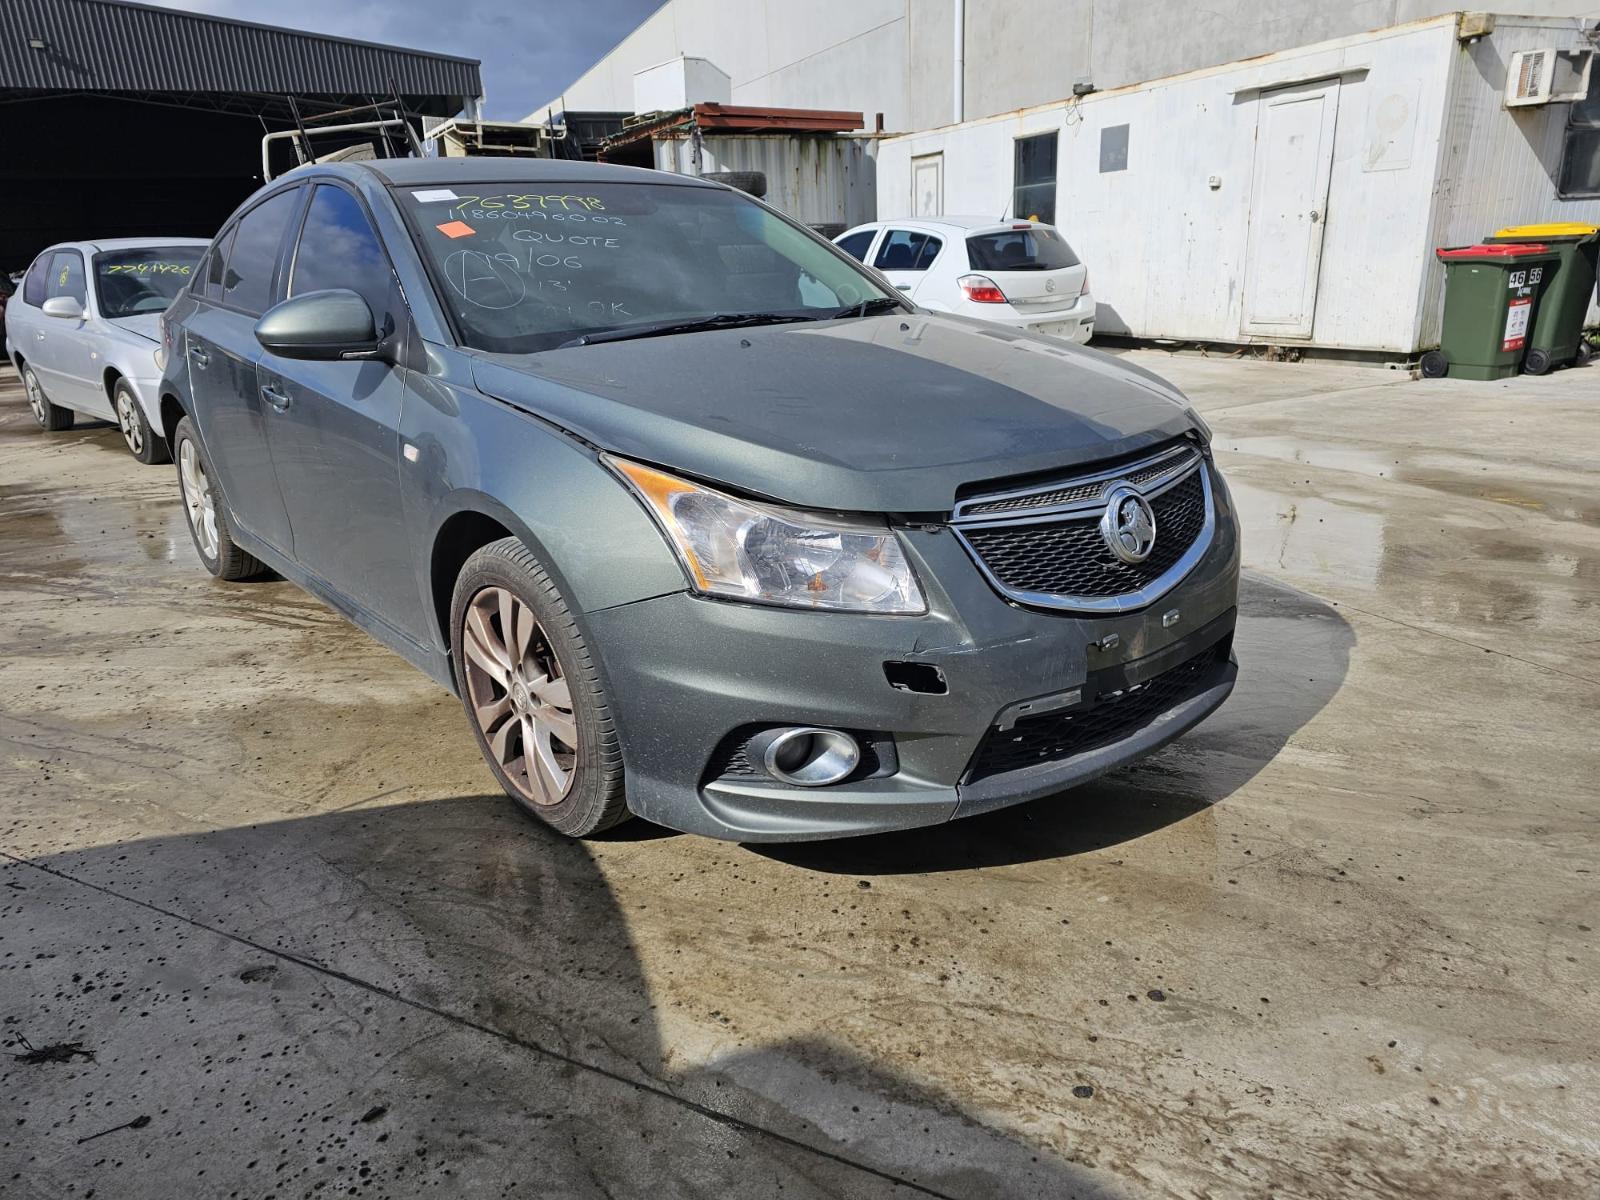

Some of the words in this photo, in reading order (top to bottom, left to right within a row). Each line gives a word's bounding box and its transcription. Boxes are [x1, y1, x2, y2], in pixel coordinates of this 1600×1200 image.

[456, 194, 606, 210] 7639998
[512, 229, 620, 248] QUOTE
[1510, 272, 1525, 285] 46
[1530, 269, 1542, 282] 56
